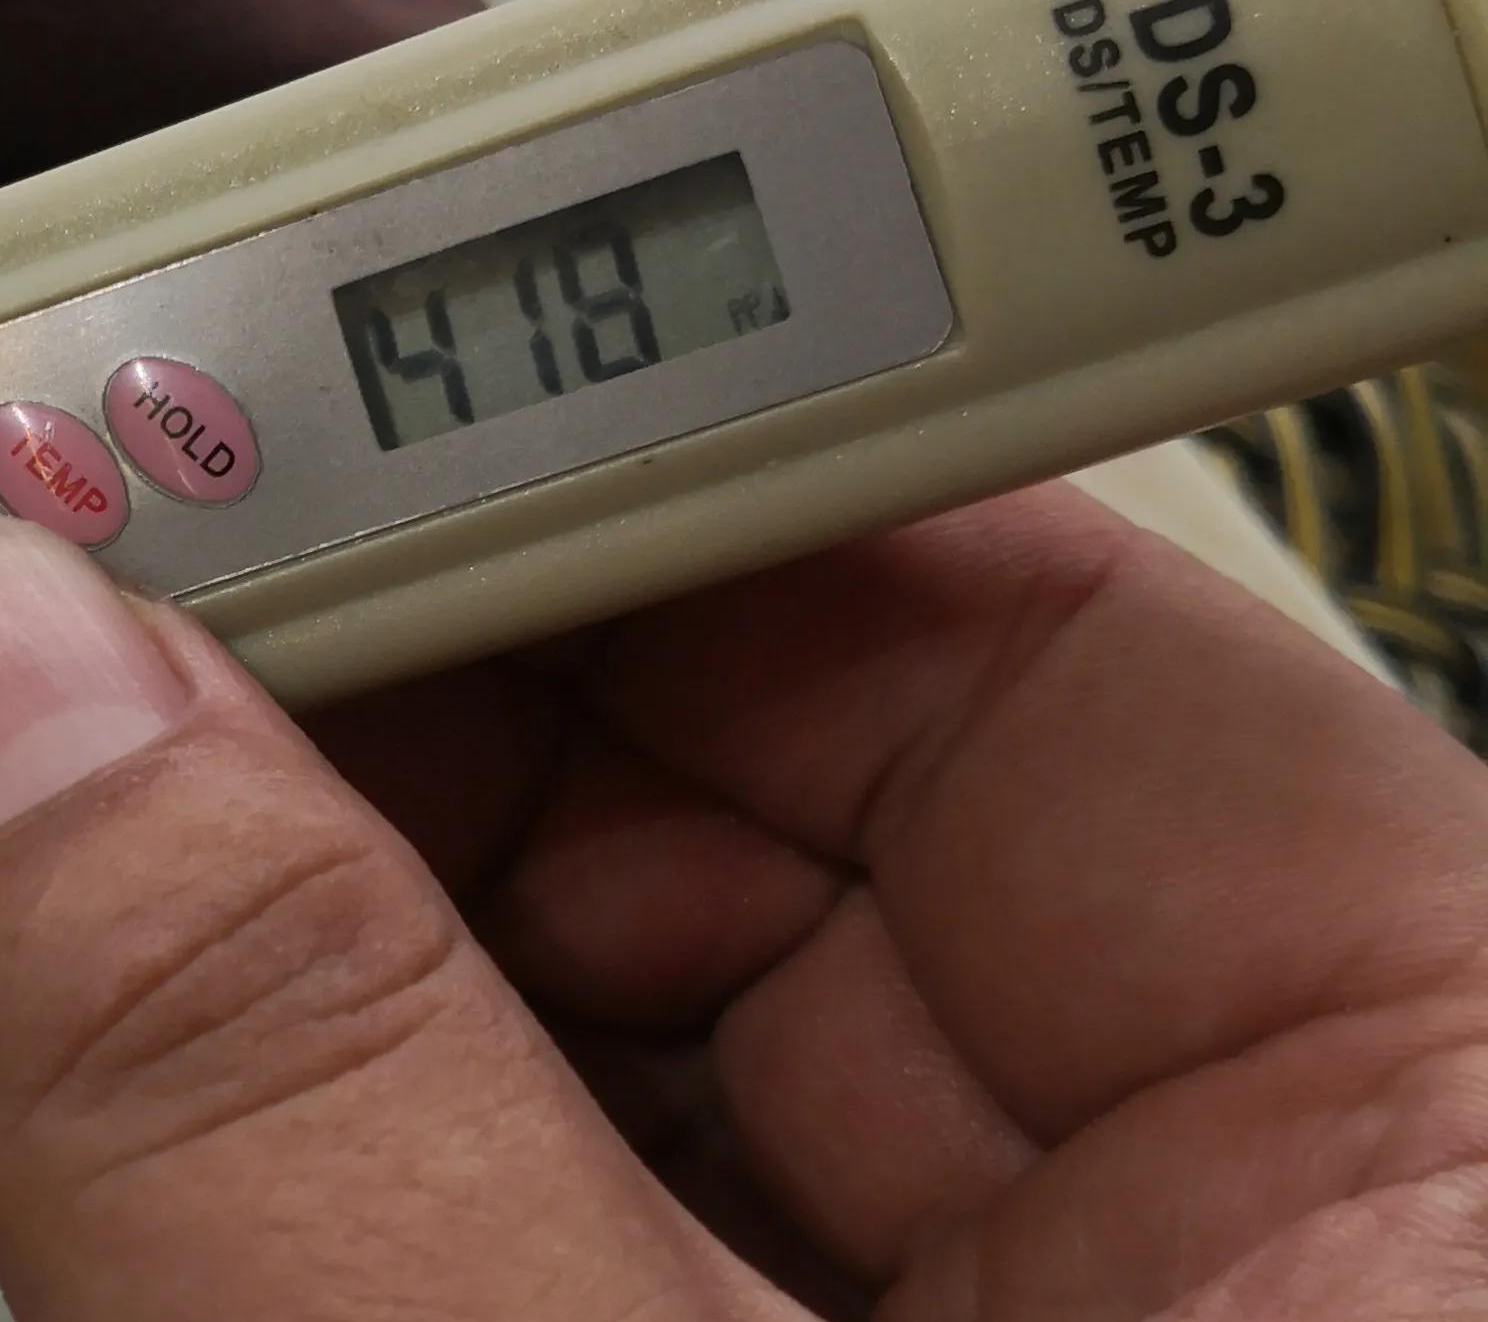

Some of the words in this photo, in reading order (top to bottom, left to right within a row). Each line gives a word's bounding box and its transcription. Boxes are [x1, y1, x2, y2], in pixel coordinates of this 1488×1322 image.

[369, 223, 661, 424] 418
[11, 425, 108, 513] TEMP
[133, 381, 236, 478] HOLD
